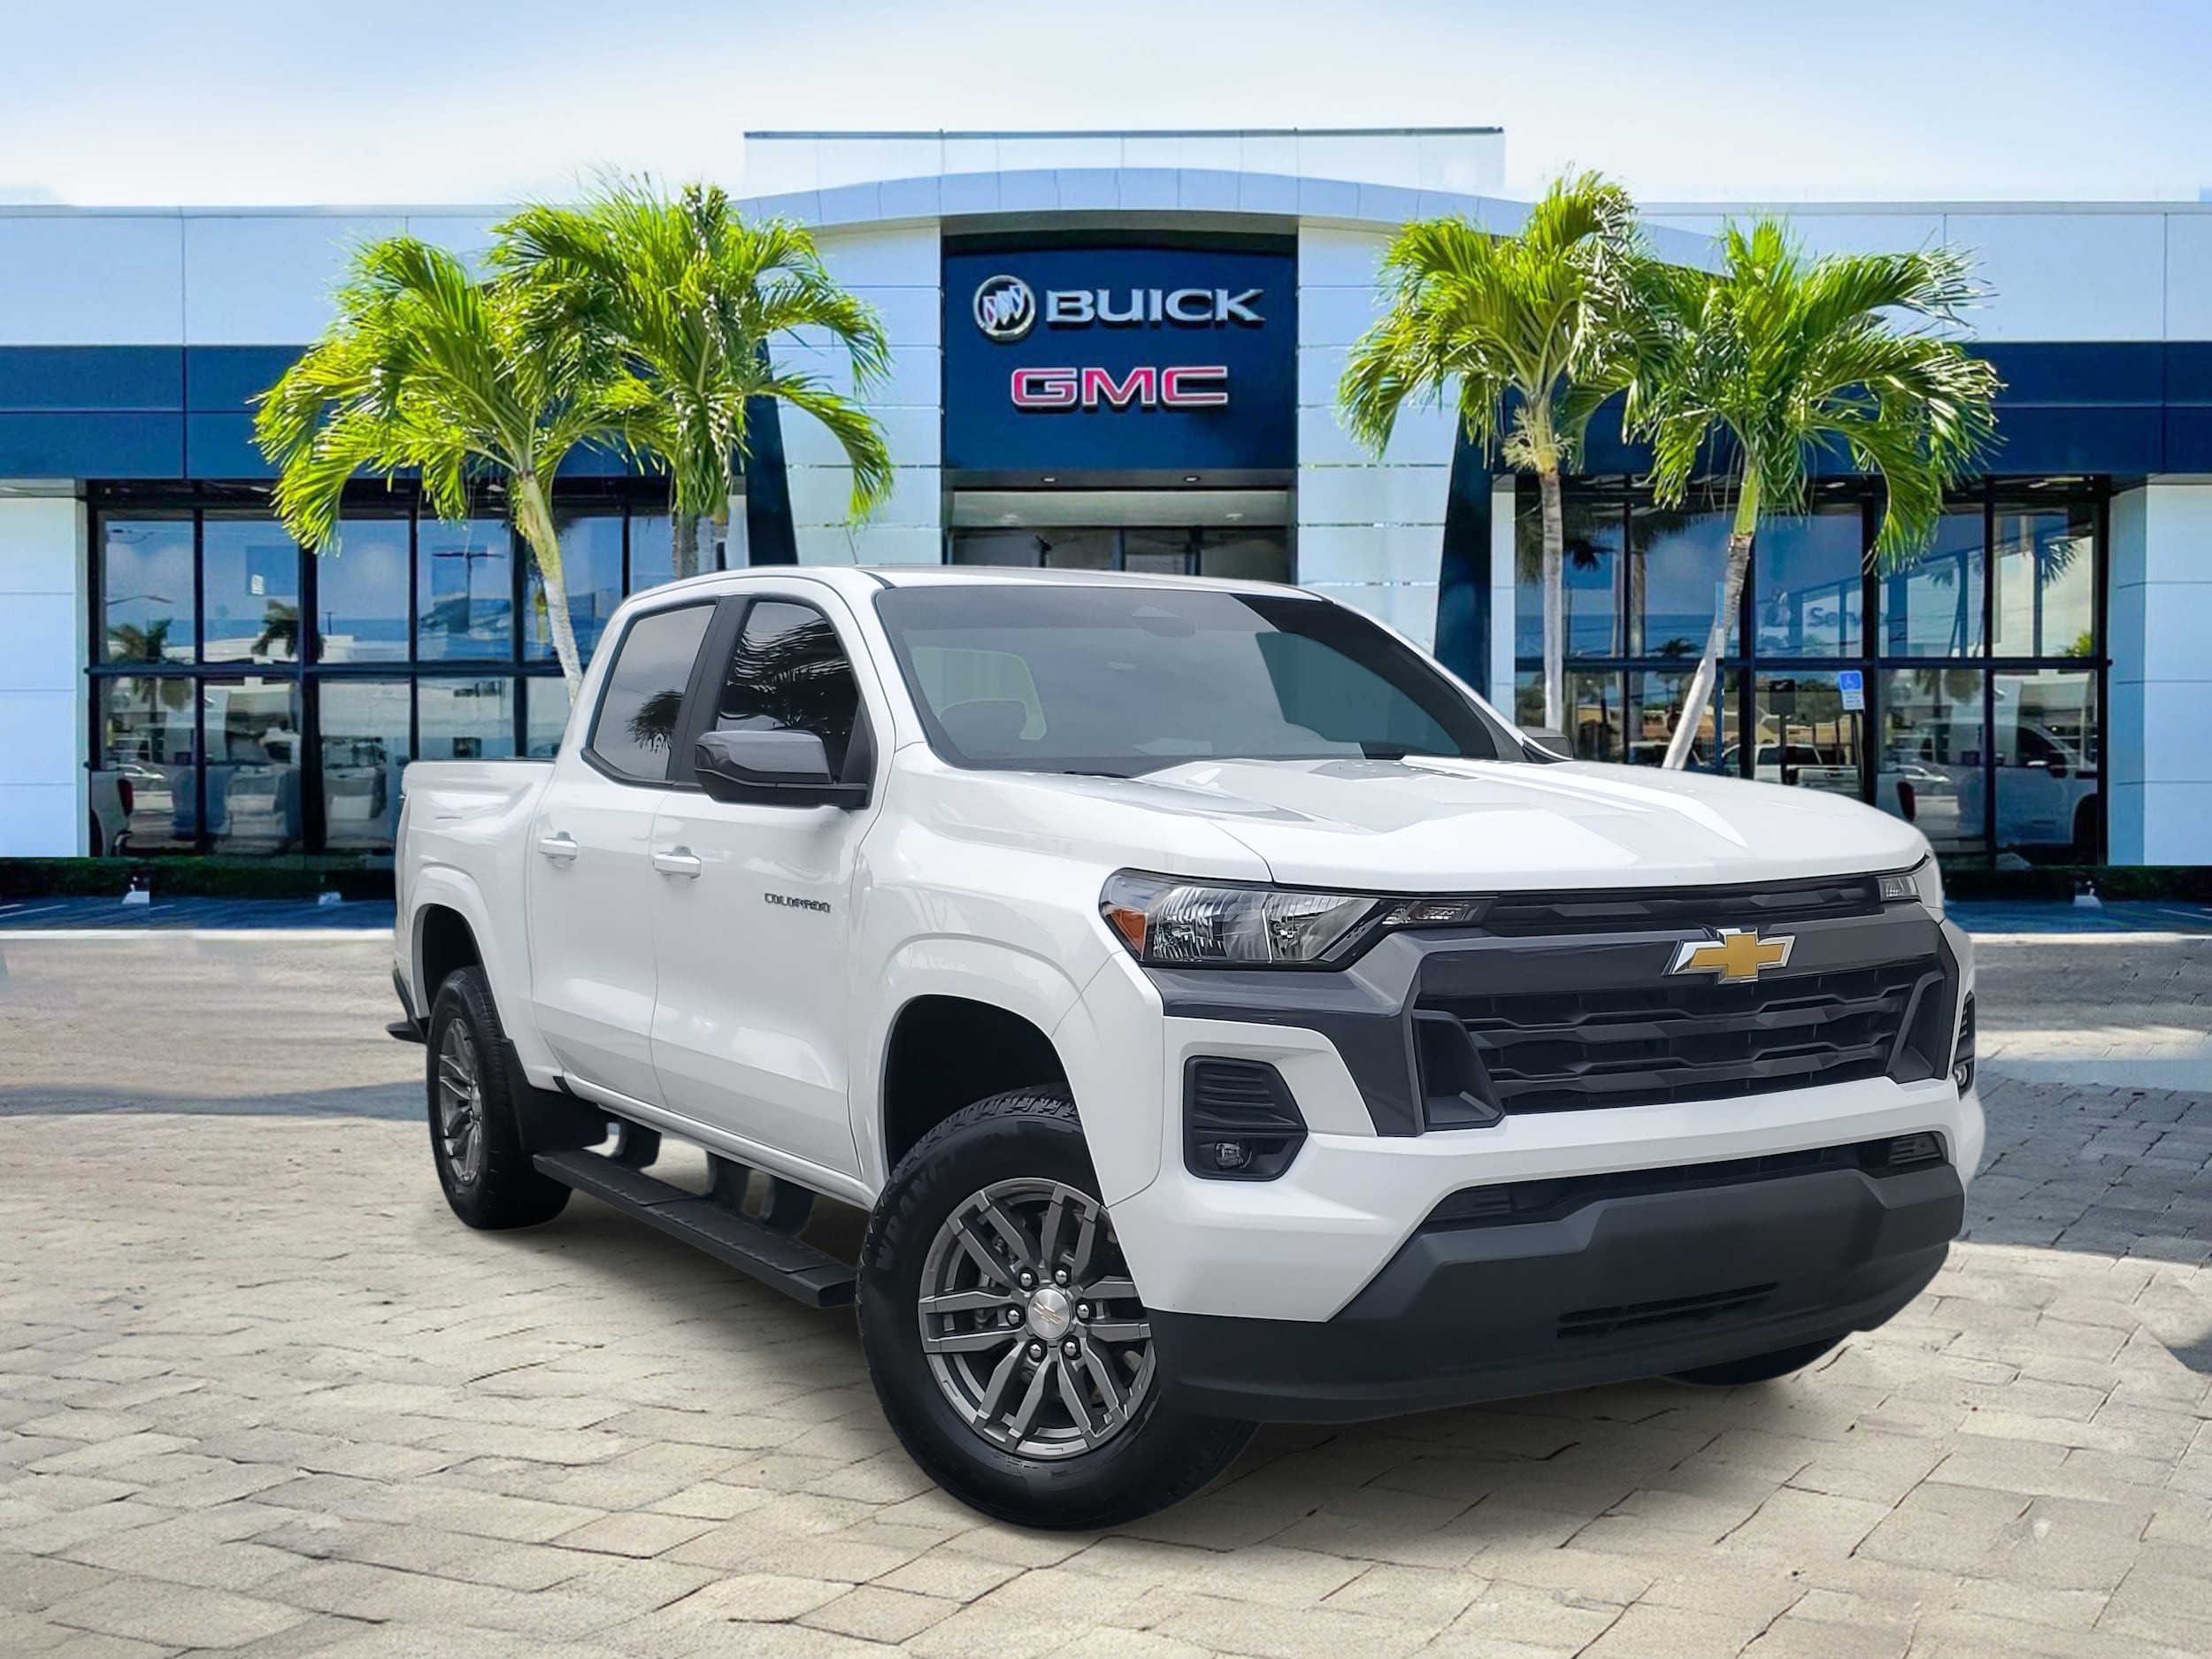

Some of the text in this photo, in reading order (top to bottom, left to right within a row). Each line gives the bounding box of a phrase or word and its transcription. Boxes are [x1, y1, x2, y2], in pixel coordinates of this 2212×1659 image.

[1046, 288, 1265, 323] BUICK
[1010, 365, 1228, 407] GMC
[764, 892, 831, 913] COLORADO
